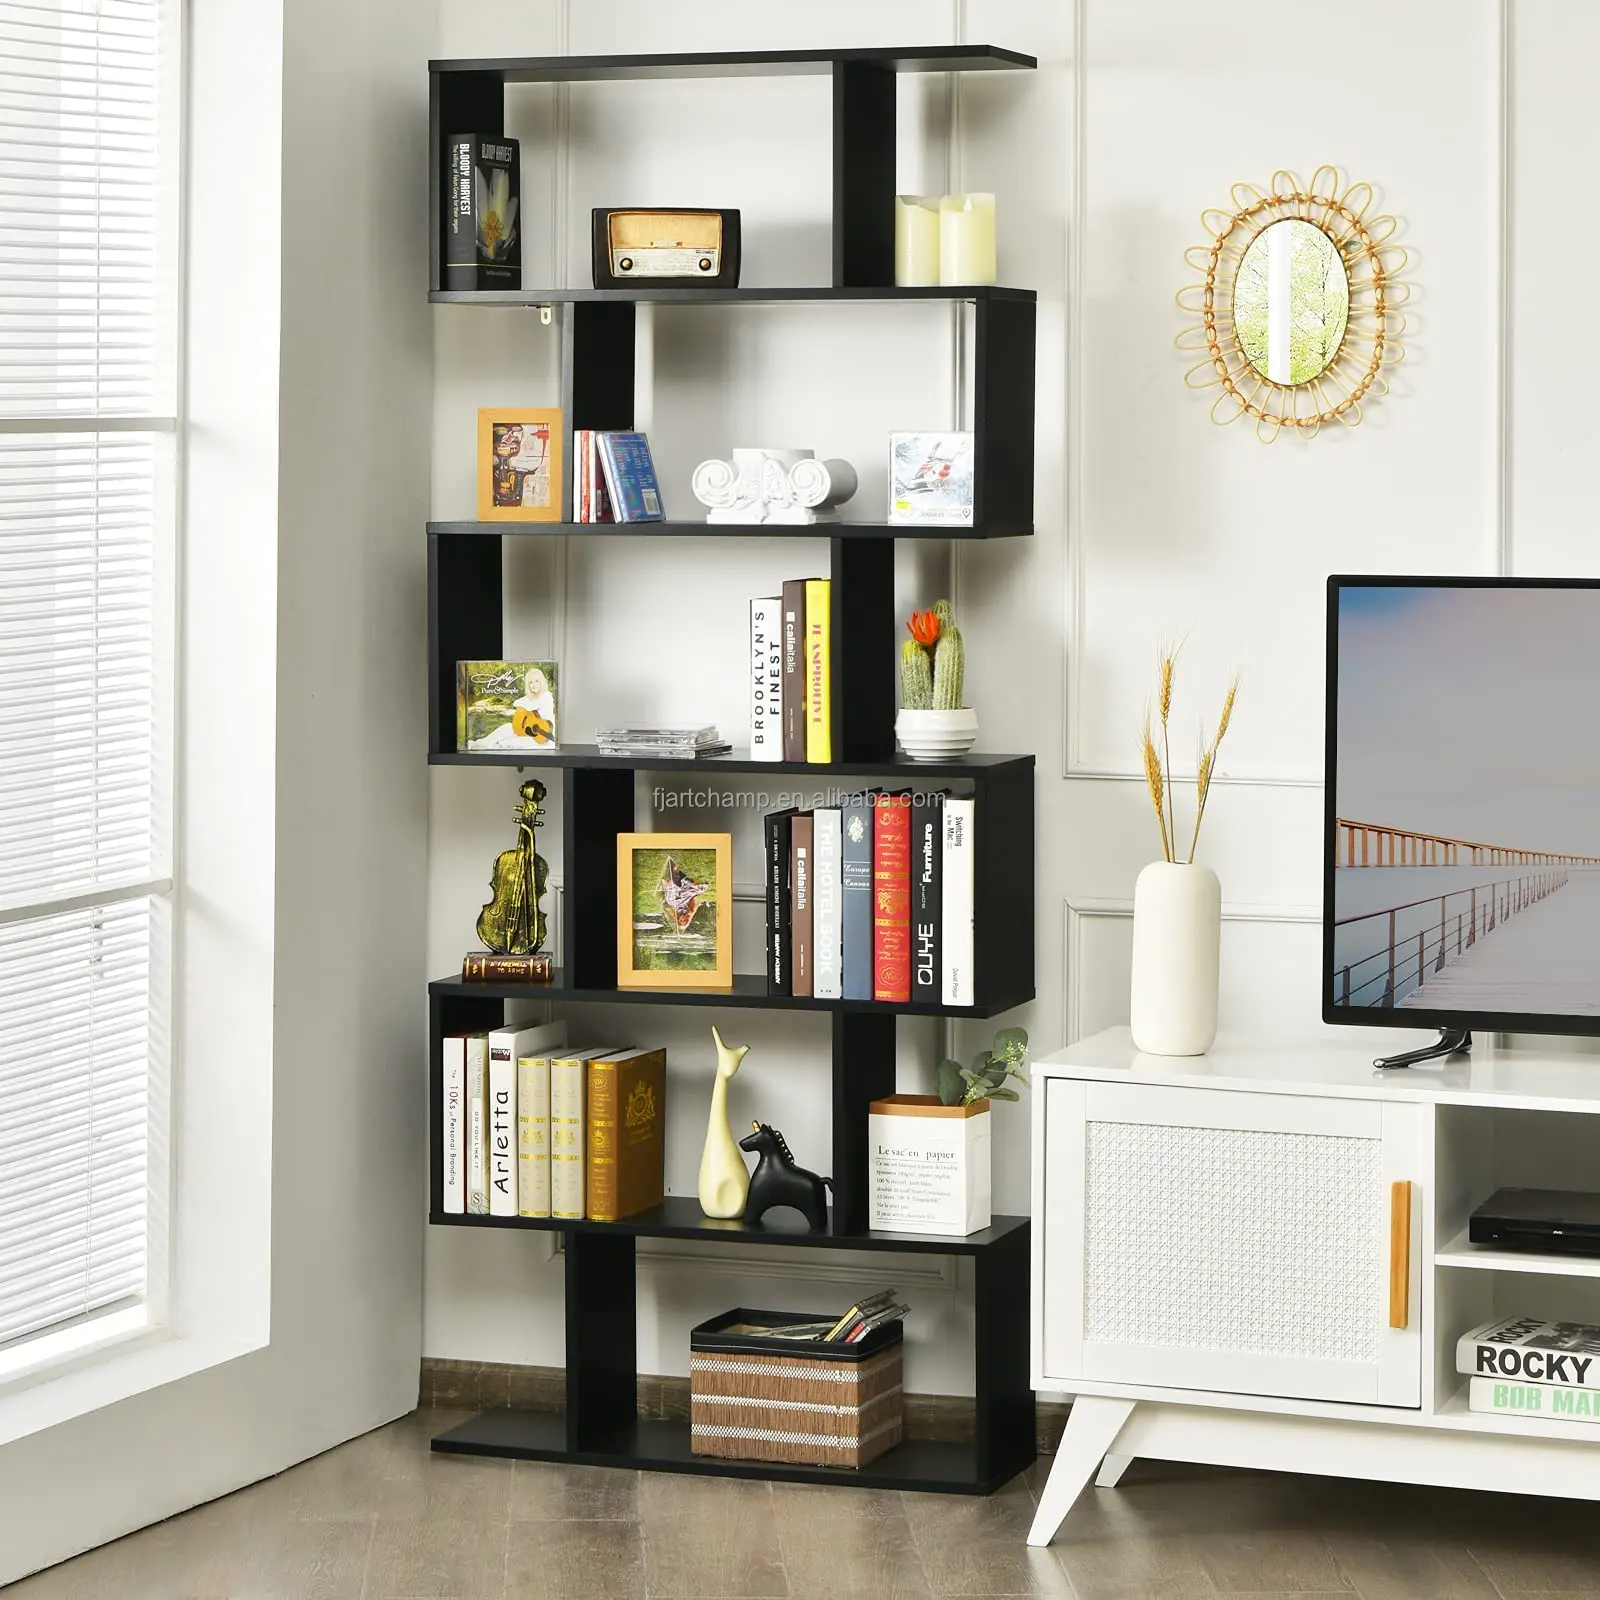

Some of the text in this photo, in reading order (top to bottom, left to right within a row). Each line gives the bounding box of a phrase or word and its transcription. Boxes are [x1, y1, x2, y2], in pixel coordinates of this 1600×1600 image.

[460, 144, 470, 216] BLOODY HARVEST
[755, 612, 764, 744] BROOKLYN'S
[770, 641, 780, 714] FINEST
[821, 820, 834, 856] THE
[923, 824, 932, 882] Furniture
[954, 816, 963, 846] Switching
[821, 862, 834, 919] HOTEL
[820, 924, 833, 975] BOOK
[449, 1086, 458, 1109] 10Ks
[493, 1091, 509, 1194] Arletta
[878, 1145, 890, 1155] Le
[926, 1152, 956, 1160] papier
[1486, 1318, 1547, 1344] ROCKY
[1476, 1345, 1592, 1384] ROCKY
[1494, 1384, 1541, 1410] BOB
